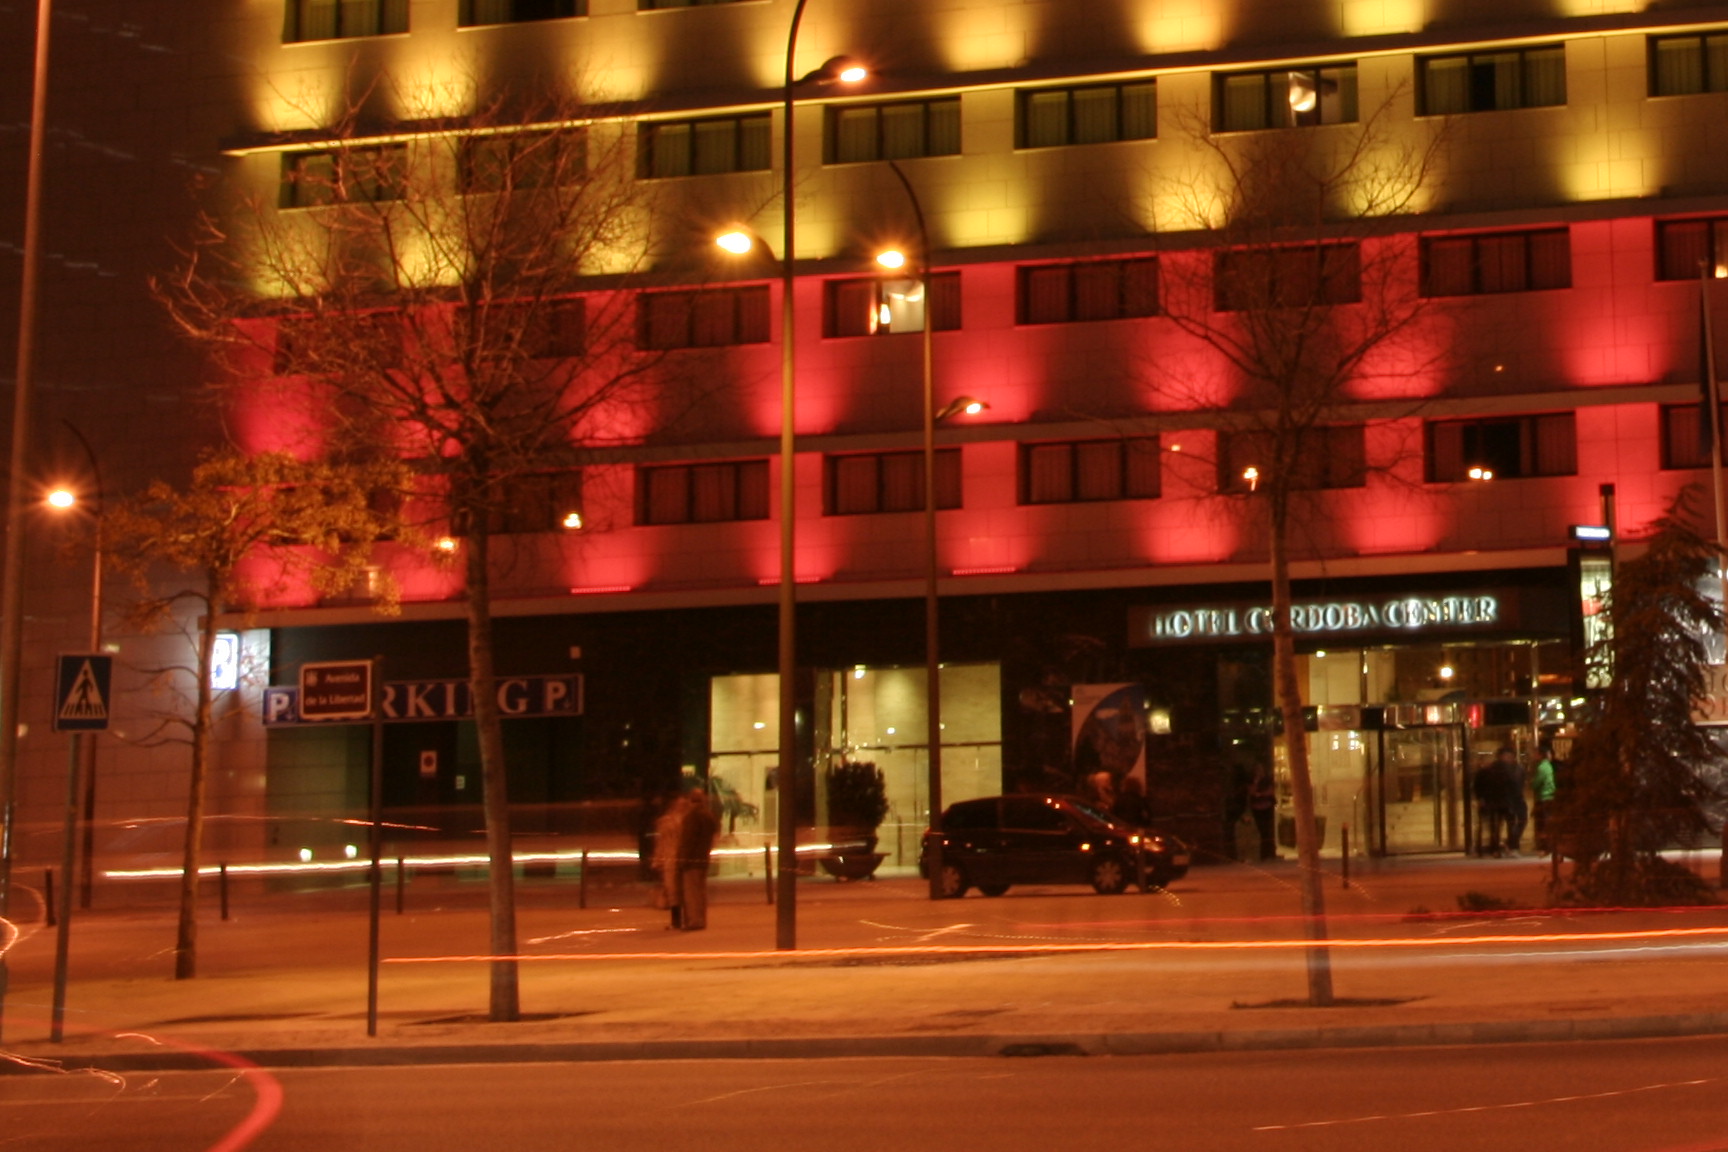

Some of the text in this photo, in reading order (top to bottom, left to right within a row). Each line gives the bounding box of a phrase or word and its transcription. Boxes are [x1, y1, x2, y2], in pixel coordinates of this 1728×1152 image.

[1381, 596, 1498, 628] CENTER
[269, 692, 289, 722] P
[545, 680, 568, 712] P
